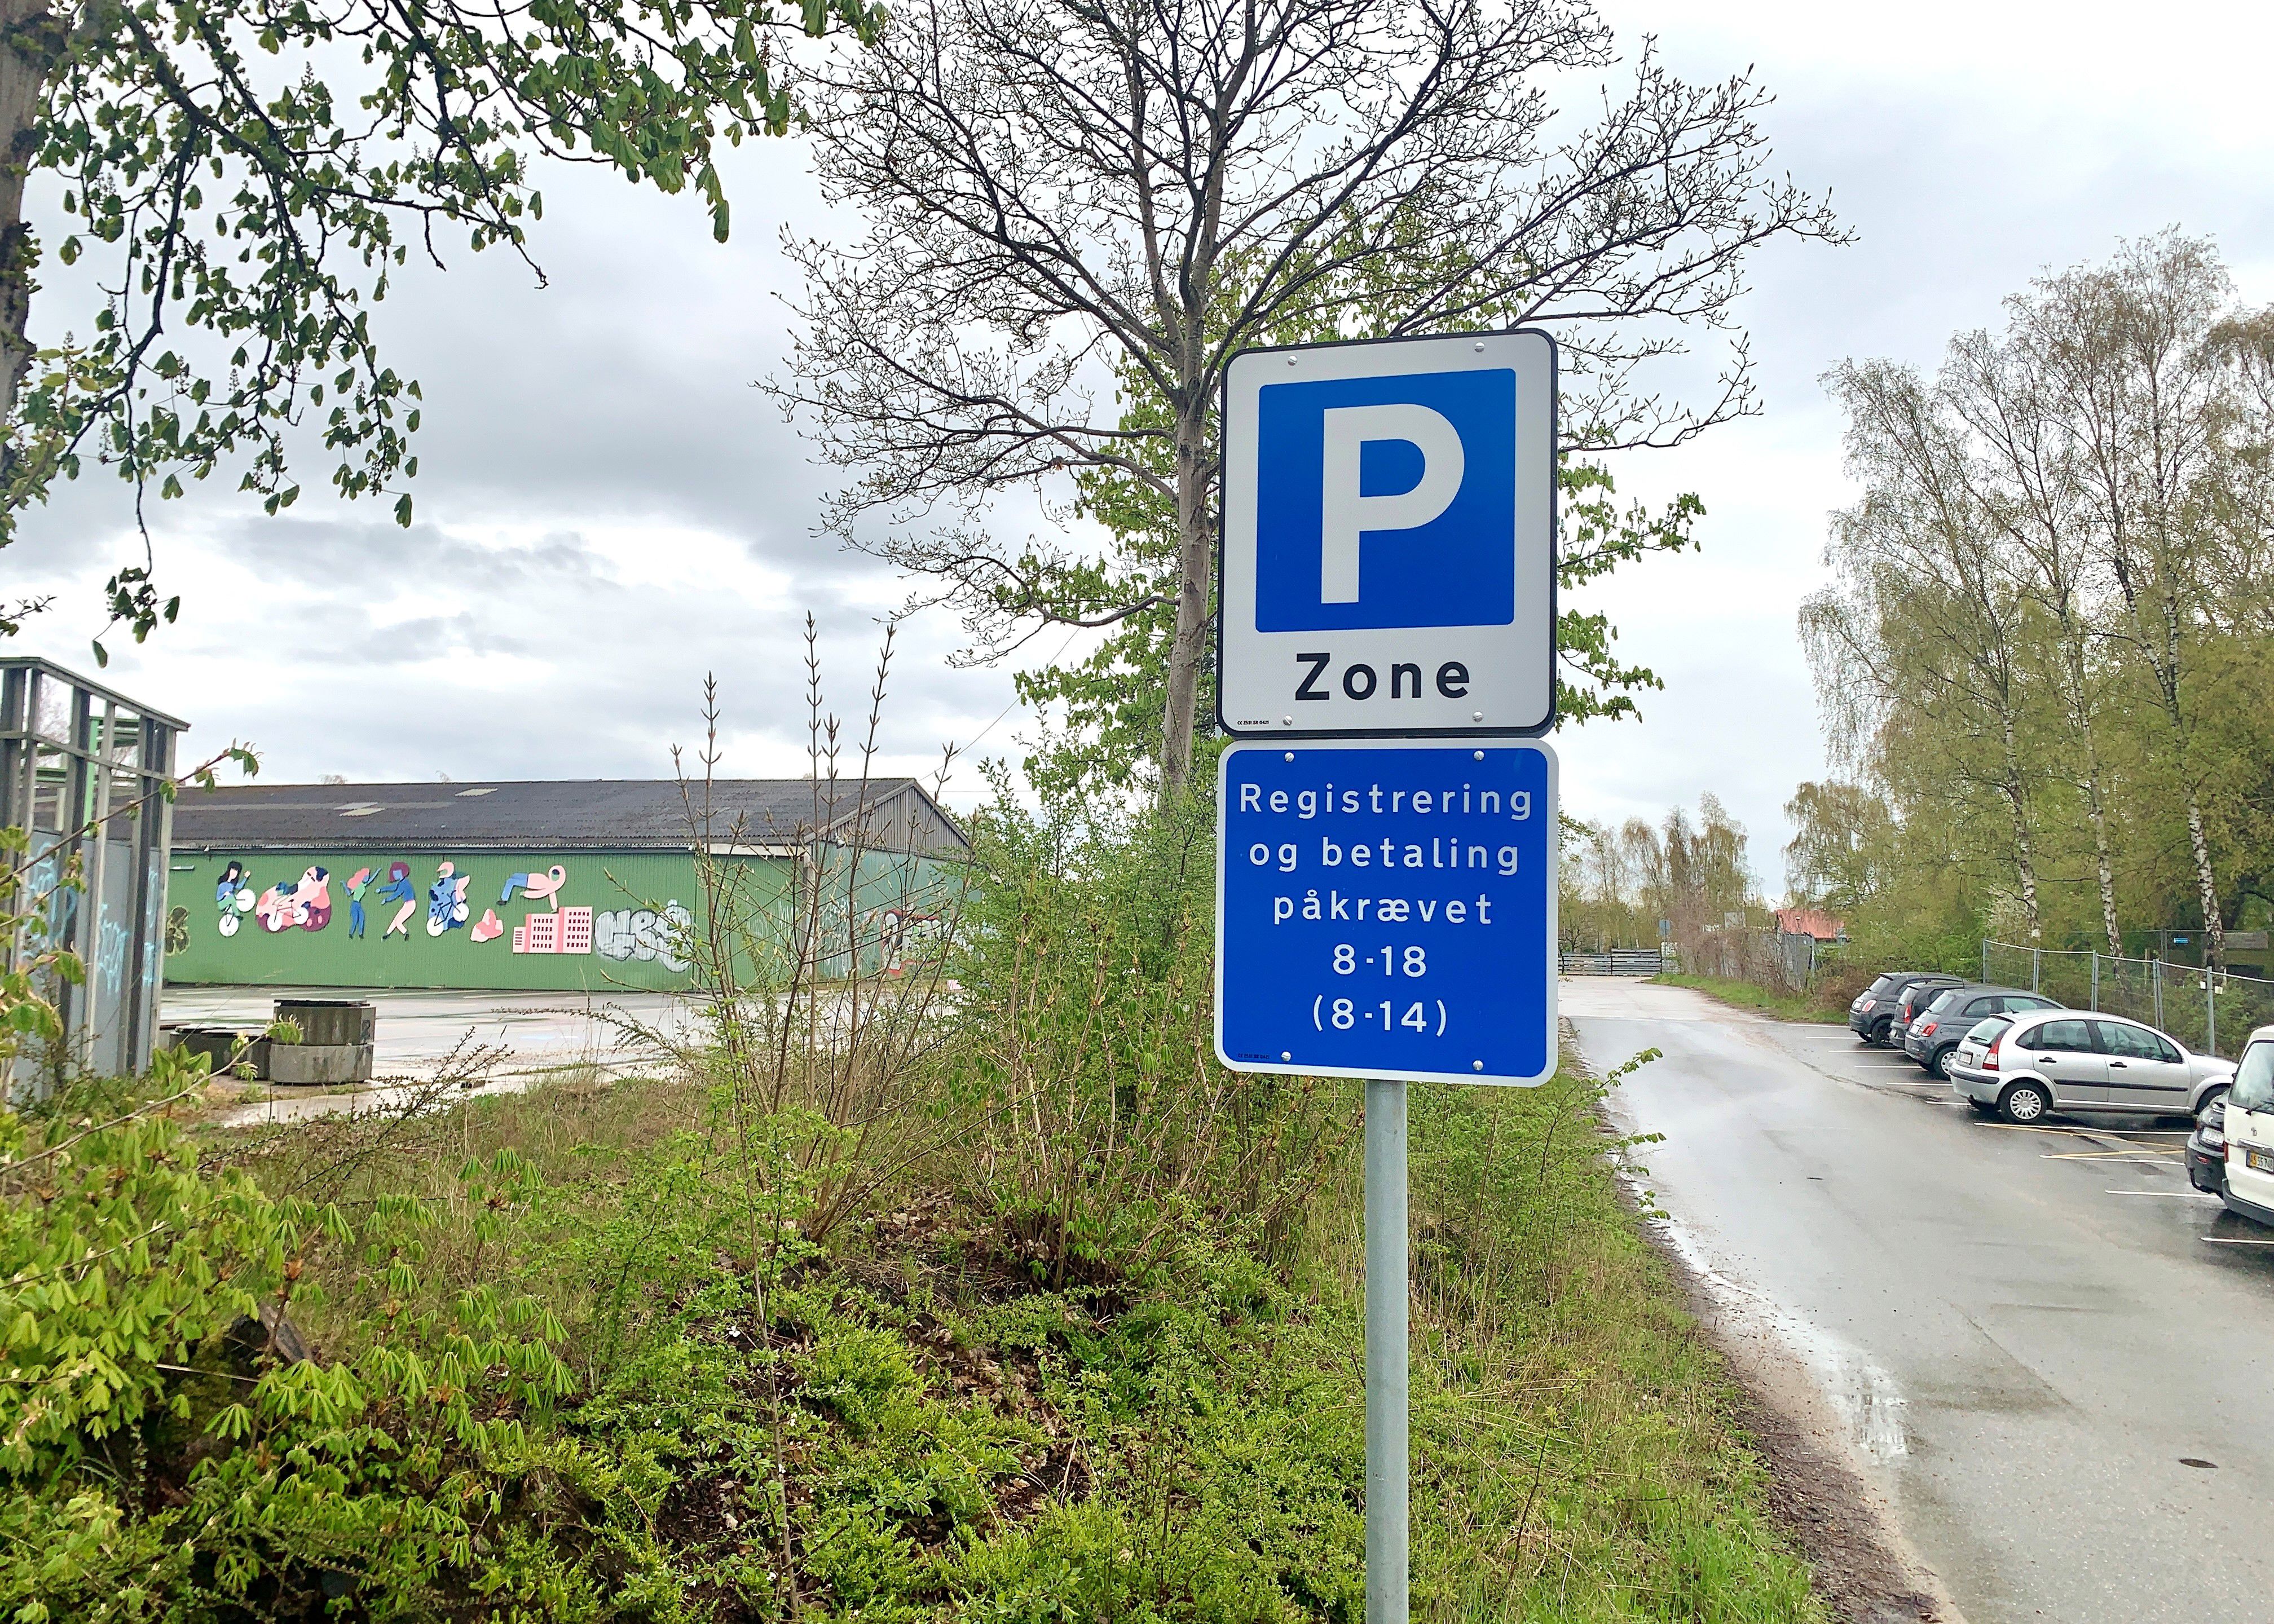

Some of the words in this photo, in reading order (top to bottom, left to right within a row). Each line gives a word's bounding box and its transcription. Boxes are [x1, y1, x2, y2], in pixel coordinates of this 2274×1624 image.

[1321, 403, 1465, 604] P
[1295, 652, 1470, 701] Zone
[1240, 783, 1531, 820] Registrering
[1249, 842, 1297, 872] og
[1323, 836, 1519, 876] betaling
[1274, 889, 1491, 925] påkrævet
[1333, 943, 1426, 977] 8-18
[1313, 994, 1447, 1037] (8-14)
